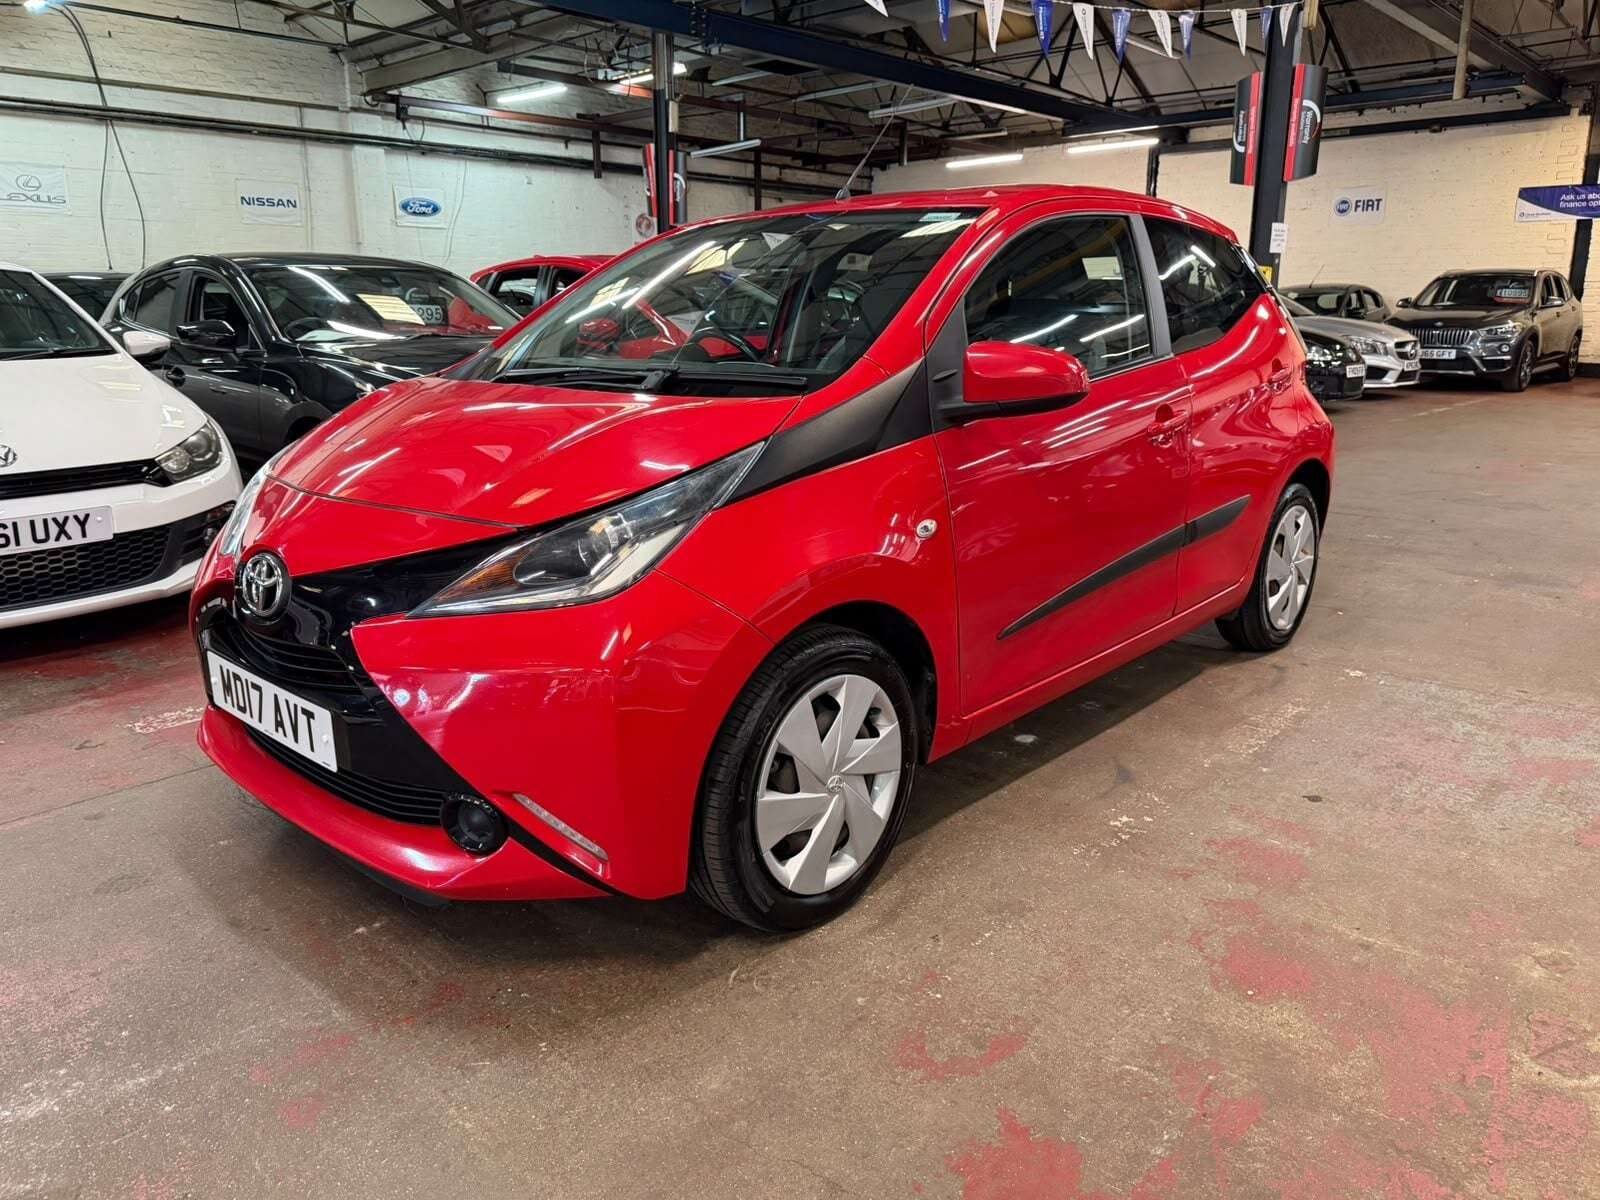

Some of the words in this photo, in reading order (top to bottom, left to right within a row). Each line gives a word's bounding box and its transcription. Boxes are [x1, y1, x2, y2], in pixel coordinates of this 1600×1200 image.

[1302, 110, 1313, 144] Warranty
[240, 196, 297, 208] NISSAN
[407, 200, 433, 213] Ford
[1354, 198, 1382, 212] FIAT
[415, 307, 442, 321] 295
[29, 513, 90, 544] UXY
[219, 664, 263, 725] MD17
[274, 693, 315, 757] AVT
